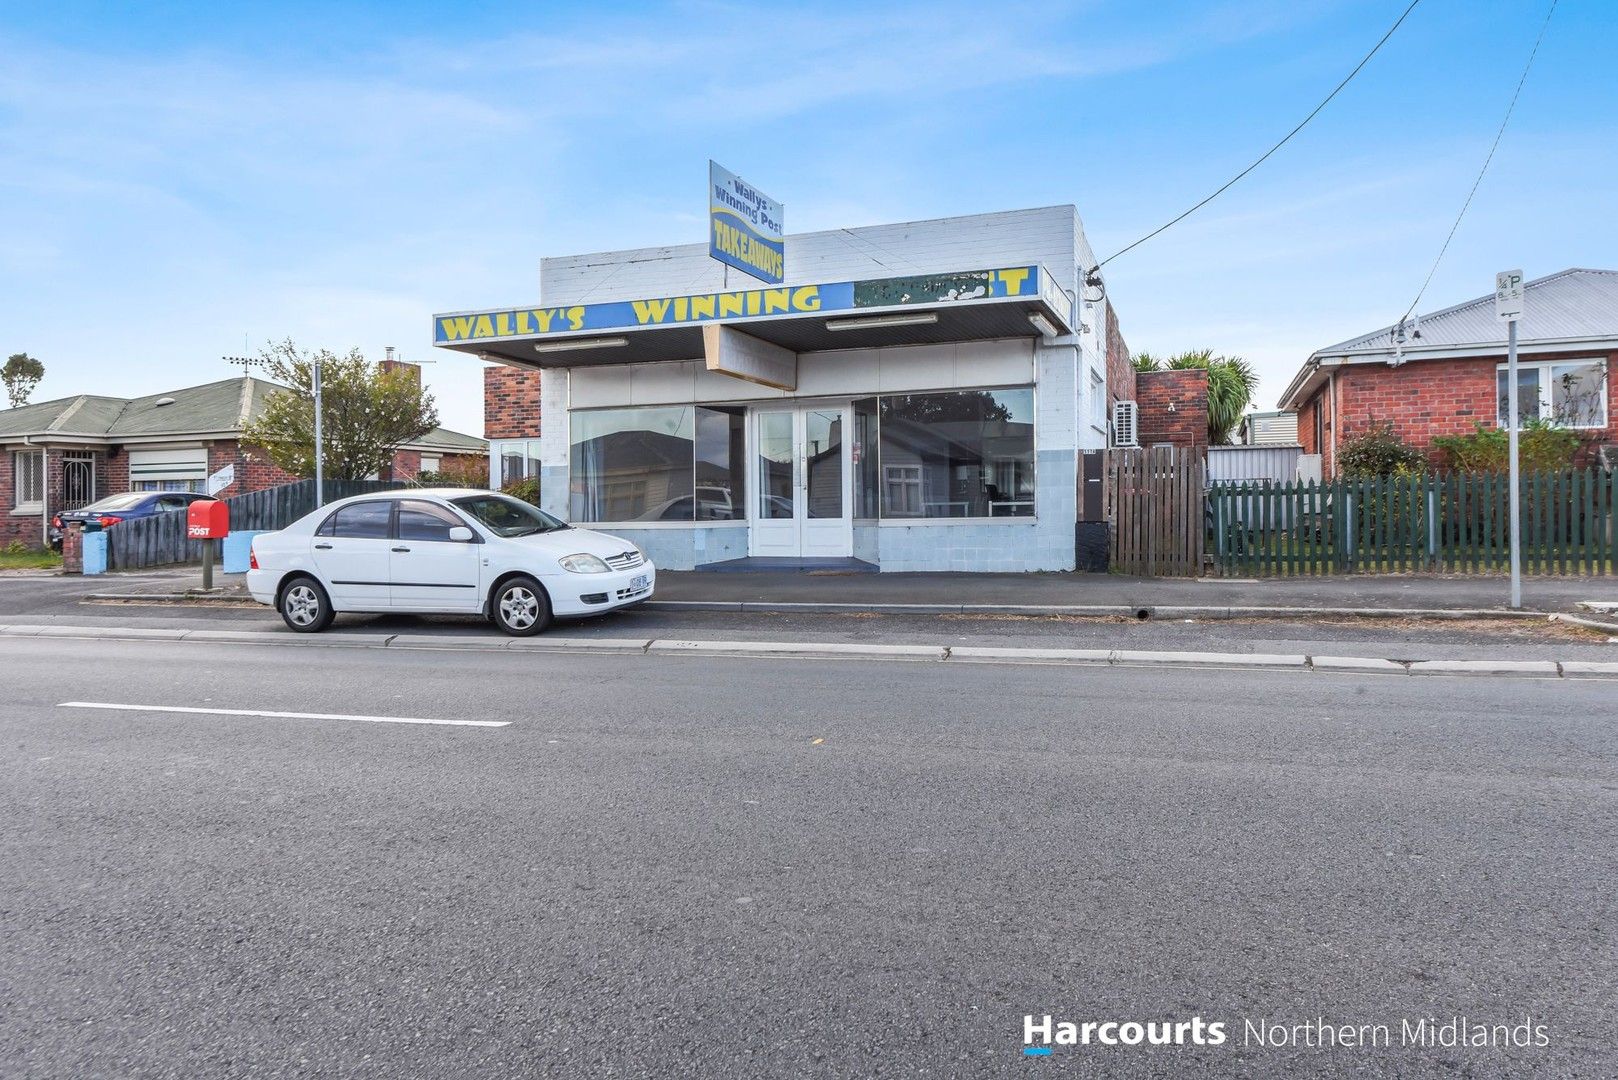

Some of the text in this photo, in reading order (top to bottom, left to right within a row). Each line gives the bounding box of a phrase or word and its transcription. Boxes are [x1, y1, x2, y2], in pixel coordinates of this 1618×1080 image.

[715, 184, 783, 236] Winning Post
[734, 180, 767, 211] Wallys
[714, 219, 783, 279] TAKEAWAYS
[441, 306, 586, 340] WALLY'S
[632, 285, 821, 324] WINNING
[188, 527, 210, 536] POST
